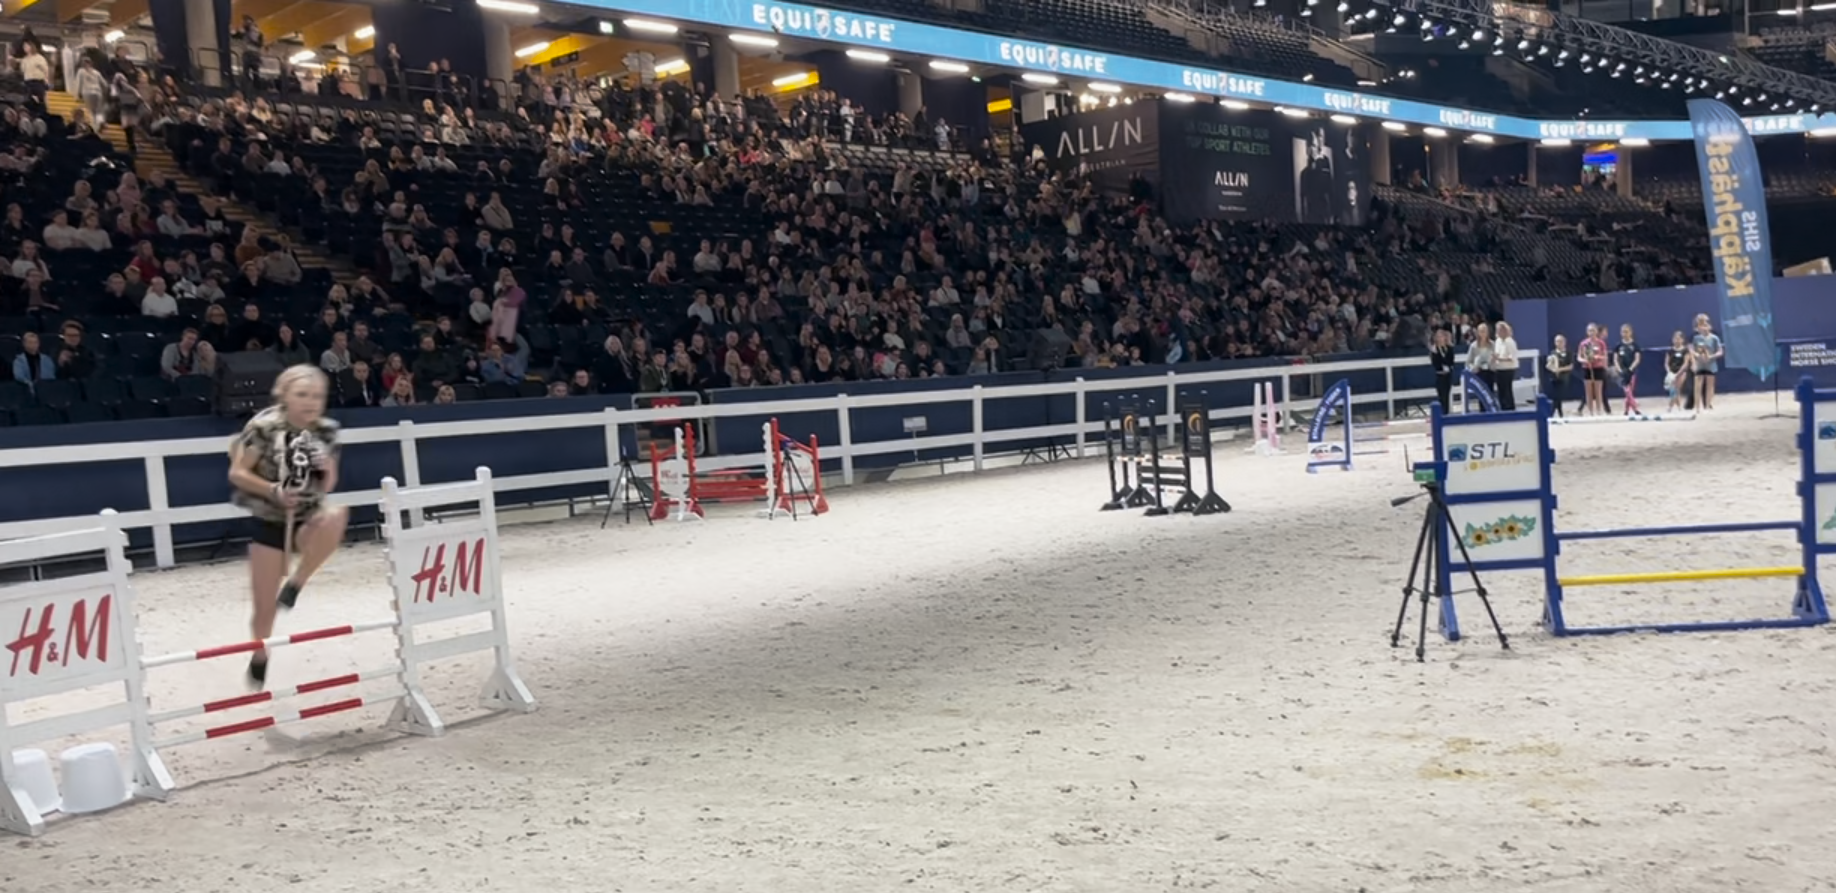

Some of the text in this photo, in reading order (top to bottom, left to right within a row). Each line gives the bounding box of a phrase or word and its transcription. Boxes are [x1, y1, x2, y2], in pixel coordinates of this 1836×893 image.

[753, 4, 893, 42] EQUI SAFE
[1000, 42, 1106, 73] EQUI SAFE
[1183, 70, 1264, 96] EQUI SAFE
[1324, 92, 1390, 114] EQUI SAFE
[1439, 109, 1495, 129] EQUI SAFE
[1540, 123, 1624, 138] EQUI SAFE
[1754, 117, 1801, 132] SAFE
[1470, 441, 1516, 460] STL
[411, 537, 486, 603] H&M
[5, 594, 112, 677] H&M
